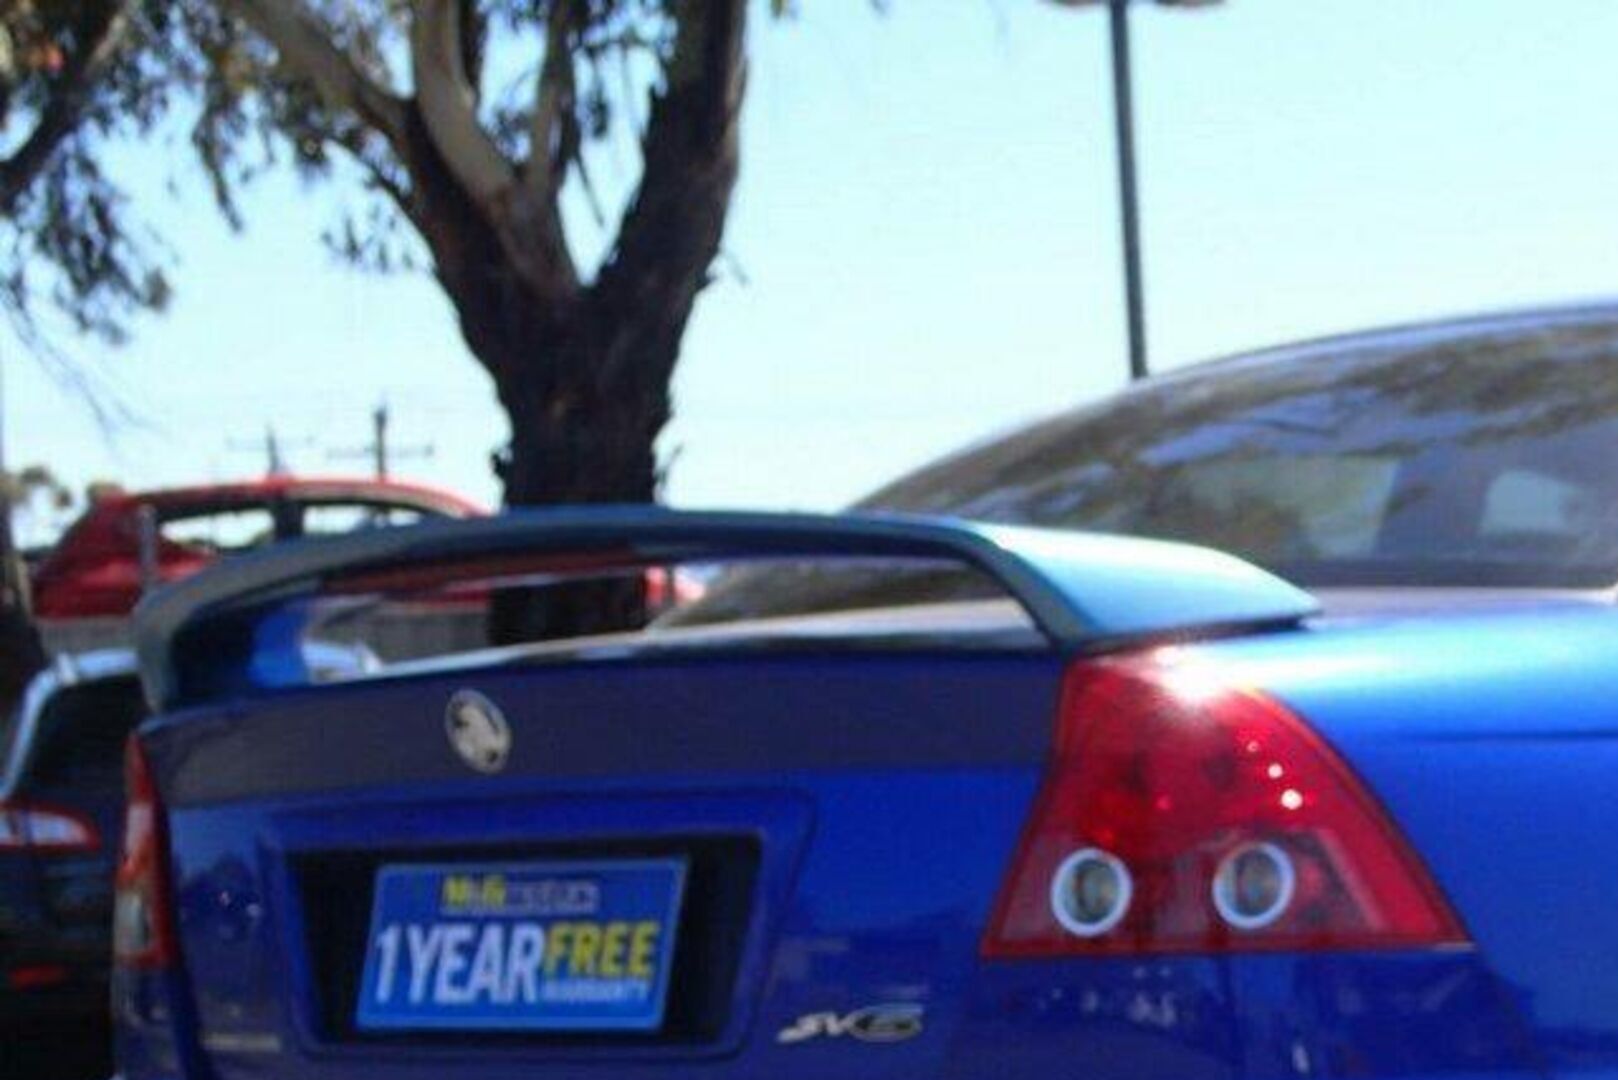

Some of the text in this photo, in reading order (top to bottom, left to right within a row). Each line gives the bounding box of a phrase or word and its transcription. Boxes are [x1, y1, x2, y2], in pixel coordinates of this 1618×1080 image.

[374, 920, 660, 1003] 1 YEAR FREE
